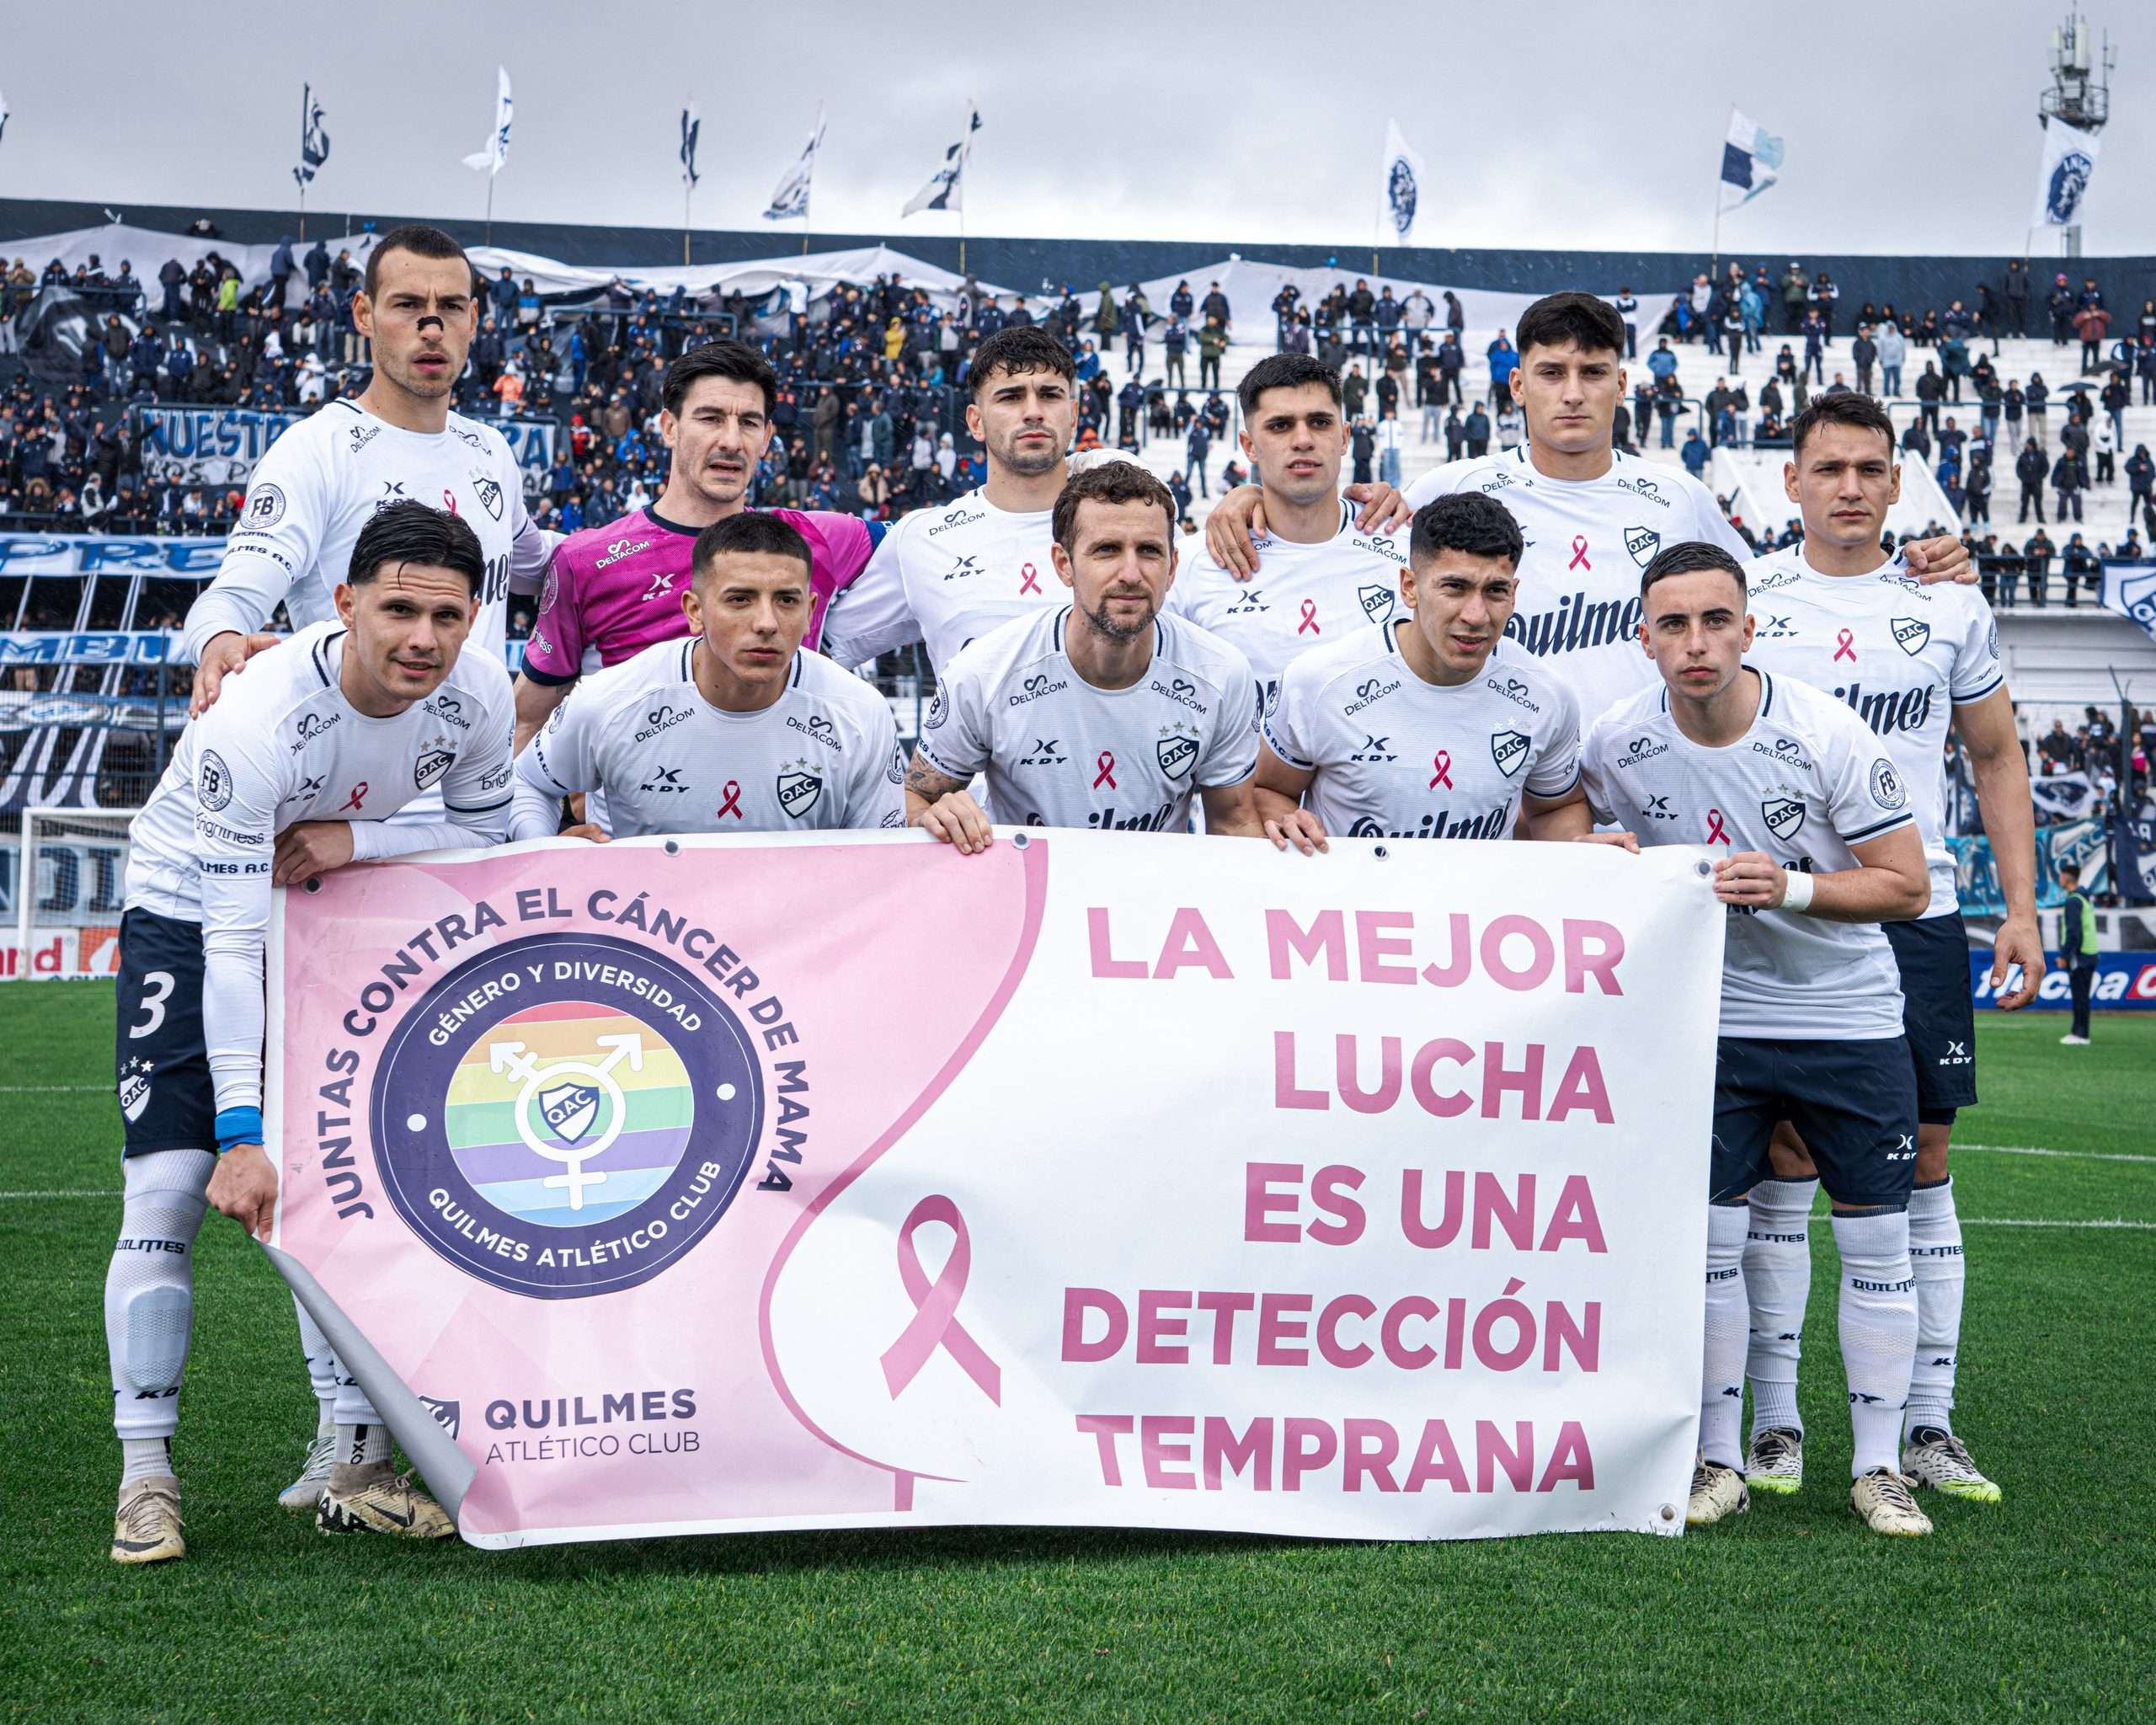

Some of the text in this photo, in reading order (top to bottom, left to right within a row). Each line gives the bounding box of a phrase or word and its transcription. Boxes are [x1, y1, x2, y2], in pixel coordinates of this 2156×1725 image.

[250, 495, 275, 518] FB
[481, 483, 500, 507] QAC
[1617, 478, 1671, 508] DELTACOM
[929, 512, 986, 536] DELTACOM
[595, 540, 650, 569] DELTACOM
[1352, 538, 1408, 565] DELTACOM
[1628, 532, 1656, 553] QAC
[943, 568, 986, 581] KDY
[1747, 573, 1802, 598] DELTACOM
[1879, 574, 1932, 602] DELTACOM
[1226, 606, 1271, 614] KDY
[1365, 590, 1390, 611] QAC
[1895, 623, 1924, 642] QAC
[1010, 680, 1069, 707] DELTACOM
[1150, 680, 1208, 715] DELTACOM
[1343, 680, 1401, 717] DELTACOM
[1486, 678, 1540, 714] DELTACOM
[424, 700, 472, 730] DELTACOM
[634, 707, 696, 743] DELTACOM
[786, 715, 842, 752] DELTACOM
[1020, 756, 1068, 766] KDY
[1161, 741, 1193, 767] QAC
[1350, 754, 1398, 762] KDY
[1494, 736, 1525, 761] QAC
[1617, 743, 1669, 769] DELTACOM
[1752, 741, 1812, 772] DELTACOM
[200, 765, 221, 793] FB
[417, 756, 448, 780] QAC
[640, 783, 691, 793] KDY
[781, 777, 816, 803] QAC
[1878, 770, 1897, 797] FB
[1642, 809, 1678, 820] KDY
[1766, 803, 1801, 826] QAC
[245, 862, 270, 873] A.C.
[1086, 907, 1625, 996] LA MEJOR
[129, 971, 175, 1039] 3
[429, 962, 702, 1046] GÉNERO Y DIVERSIDAD
[318, 888, 810, 1220] JUNTAS CONTRA EL CÁNCER DE MAMA
[1940, 1056, 1972, 1065] KDY
[1273, 1031, 1615, 1124] LUCHA
[120, 1077, 149, 1108] QAC
[547, 1089, 592, 1125] QAC
[1886, 1151, 1917, 1160] KDY
[429, 1161, 721, 1268] QUILMES ATLÉTICO CLUB
[1244, 1162, 1609, 1253] ES UNA
[1061, 1276, 1601, 1372] DETECCIÓN
[484, 1389, 697, 1430] QUILMES
[486, 1431, 700, 1465] ATLÉTICO CLUB
[1075, 1414, 1594, 1493] TEMPRANA
